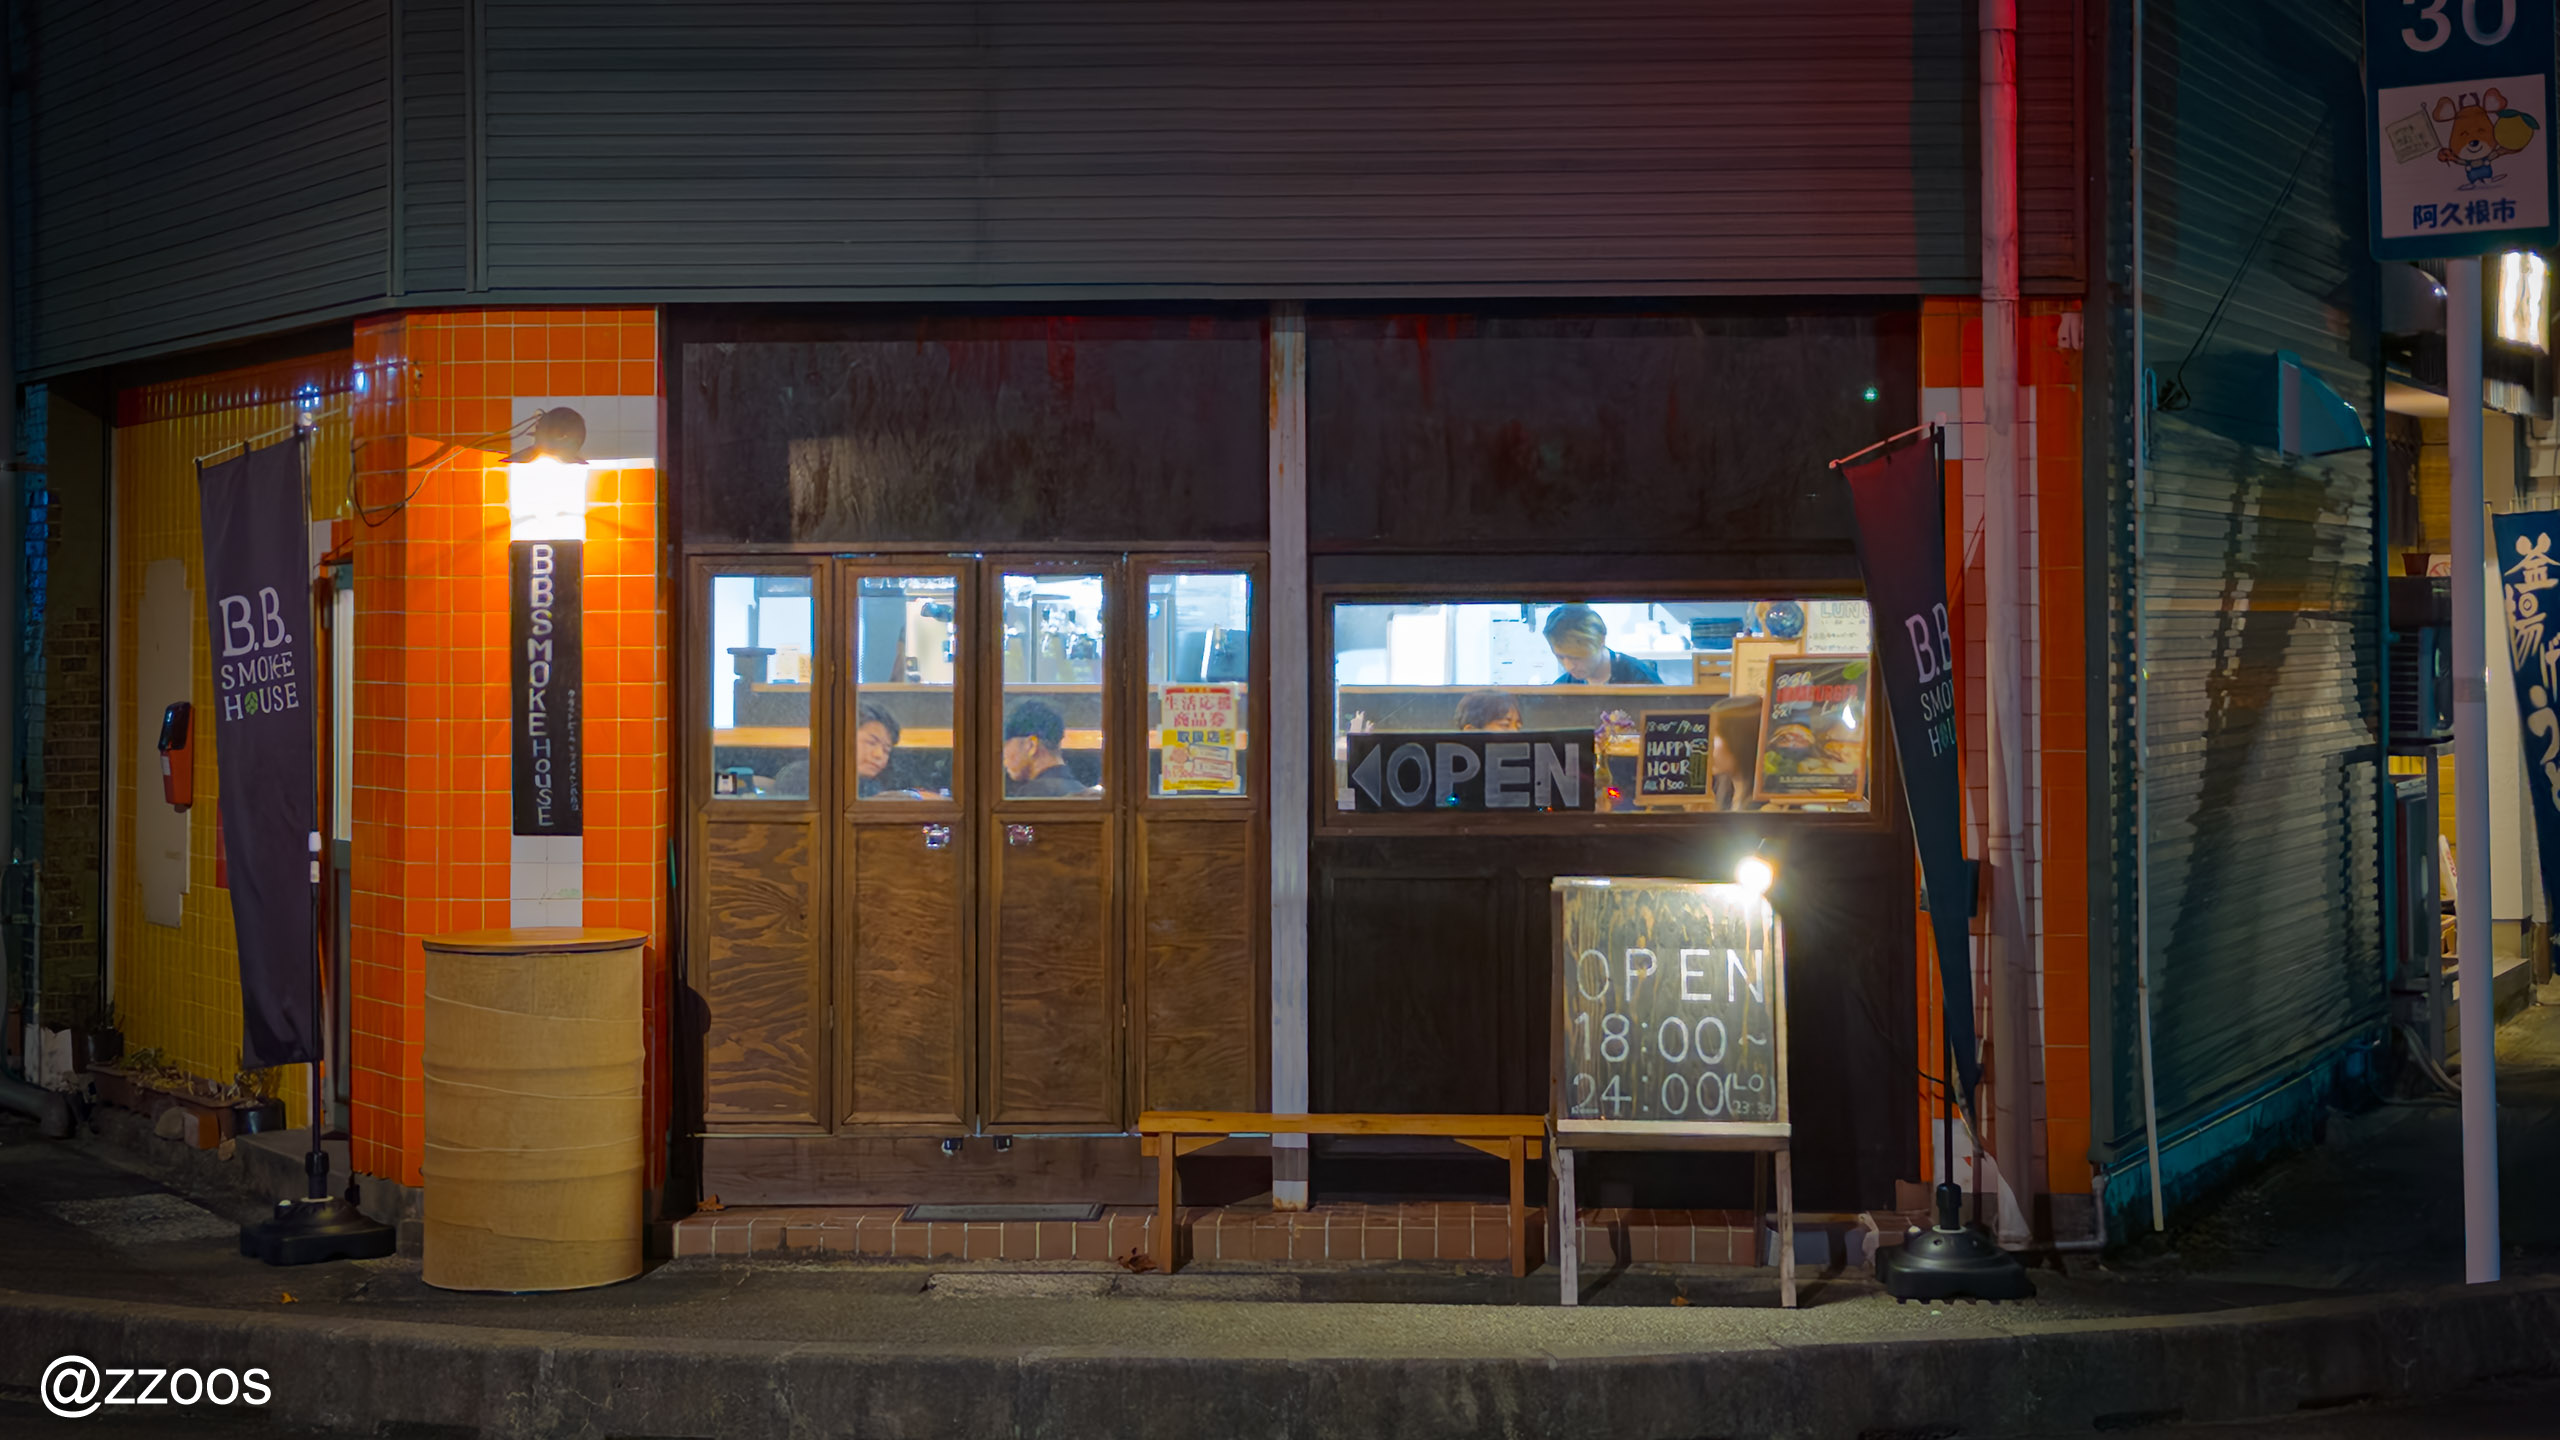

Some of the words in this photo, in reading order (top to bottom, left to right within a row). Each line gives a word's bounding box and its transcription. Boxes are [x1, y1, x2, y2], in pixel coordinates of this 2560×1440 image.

[2402, 0, 2516, 52] 30
[2413, 198, 2517, 229] 阿久根市
[219, 587, 293, 657] B.B.
[221, 651, 295, 690] SMOKE
[1920, 680, 1954, 722] SMO
[1646, 740, 1693, 757] HAPPY
[1647, 760, 1693, 777] HOUR
[1386, 742, 1580, 807] OPEN
[1577, 948, 1763, 1003] OPEN
